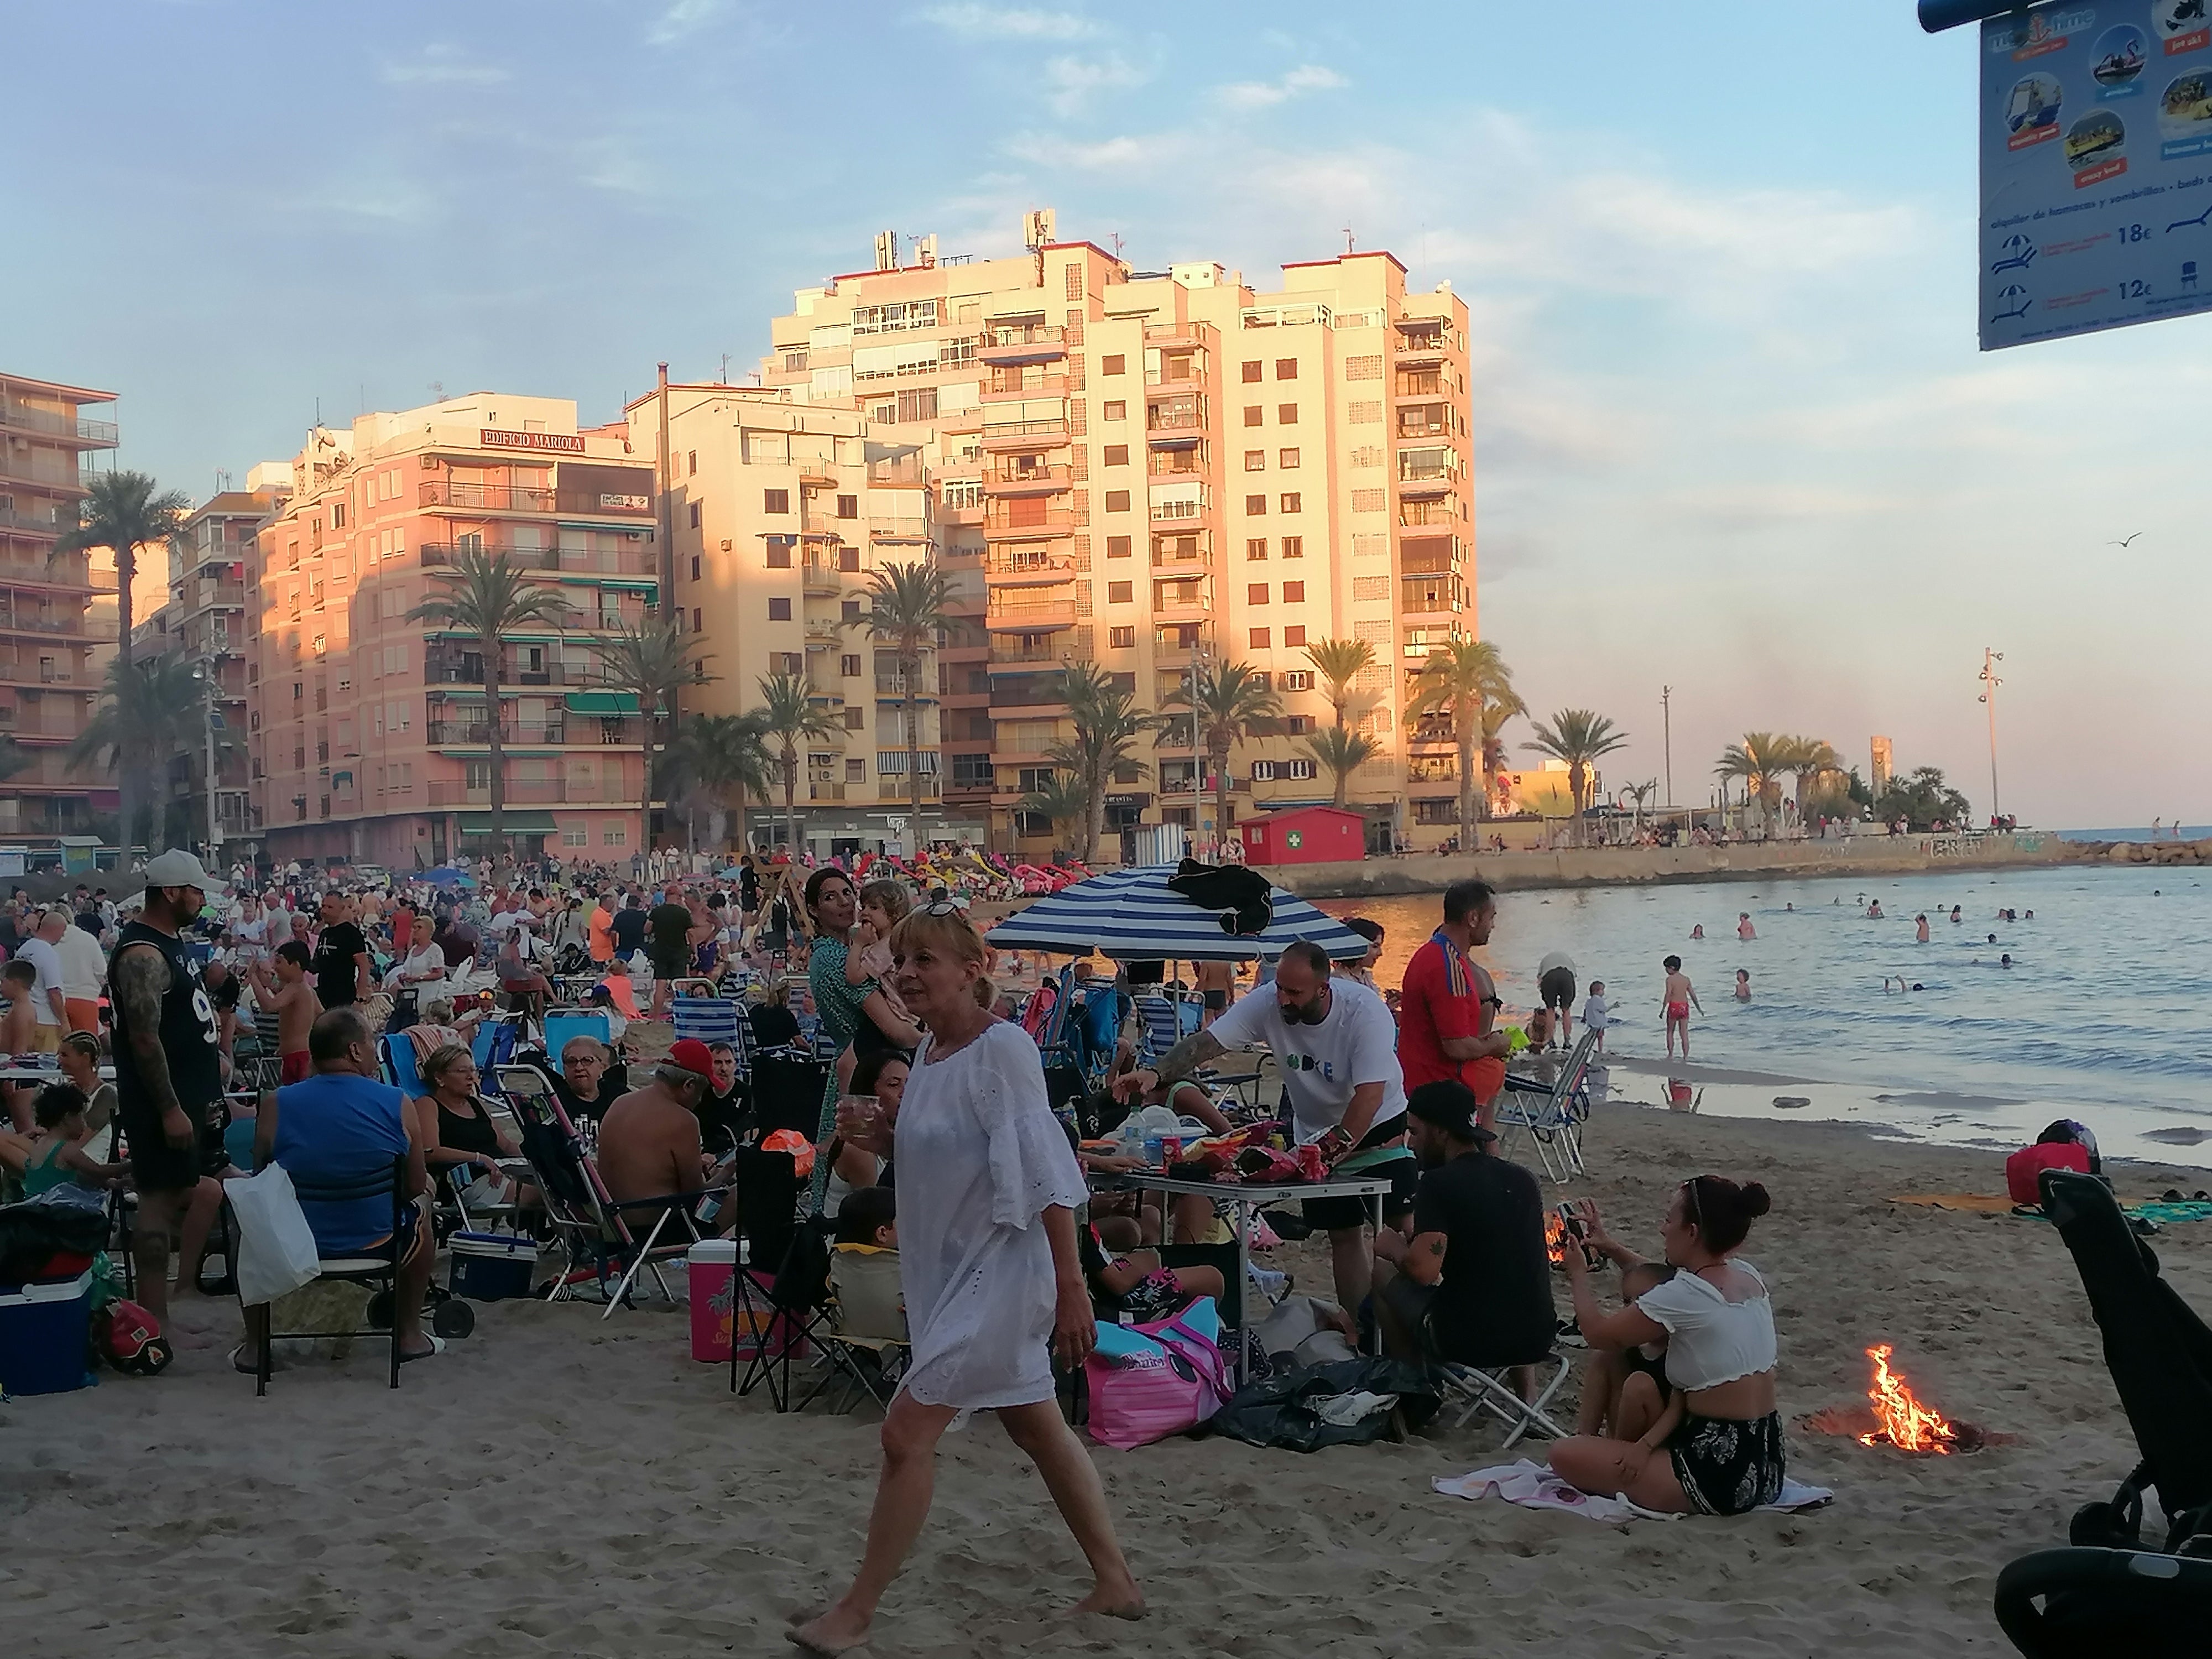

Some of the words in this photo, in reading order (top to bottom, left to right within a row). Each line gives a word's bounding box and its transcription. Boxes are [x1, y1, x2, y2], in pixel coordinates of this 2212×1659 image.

[2033, 210, 2046, 220] de
[2048, 201, 2096, 216] hamacas
[2099, 199, 2106, 210] y
[2109, 186, 2166, 204] sombrillas
[484, 430, 530, 447] EDIFICIO
[534, 434, 582, 451] MARIOLA
